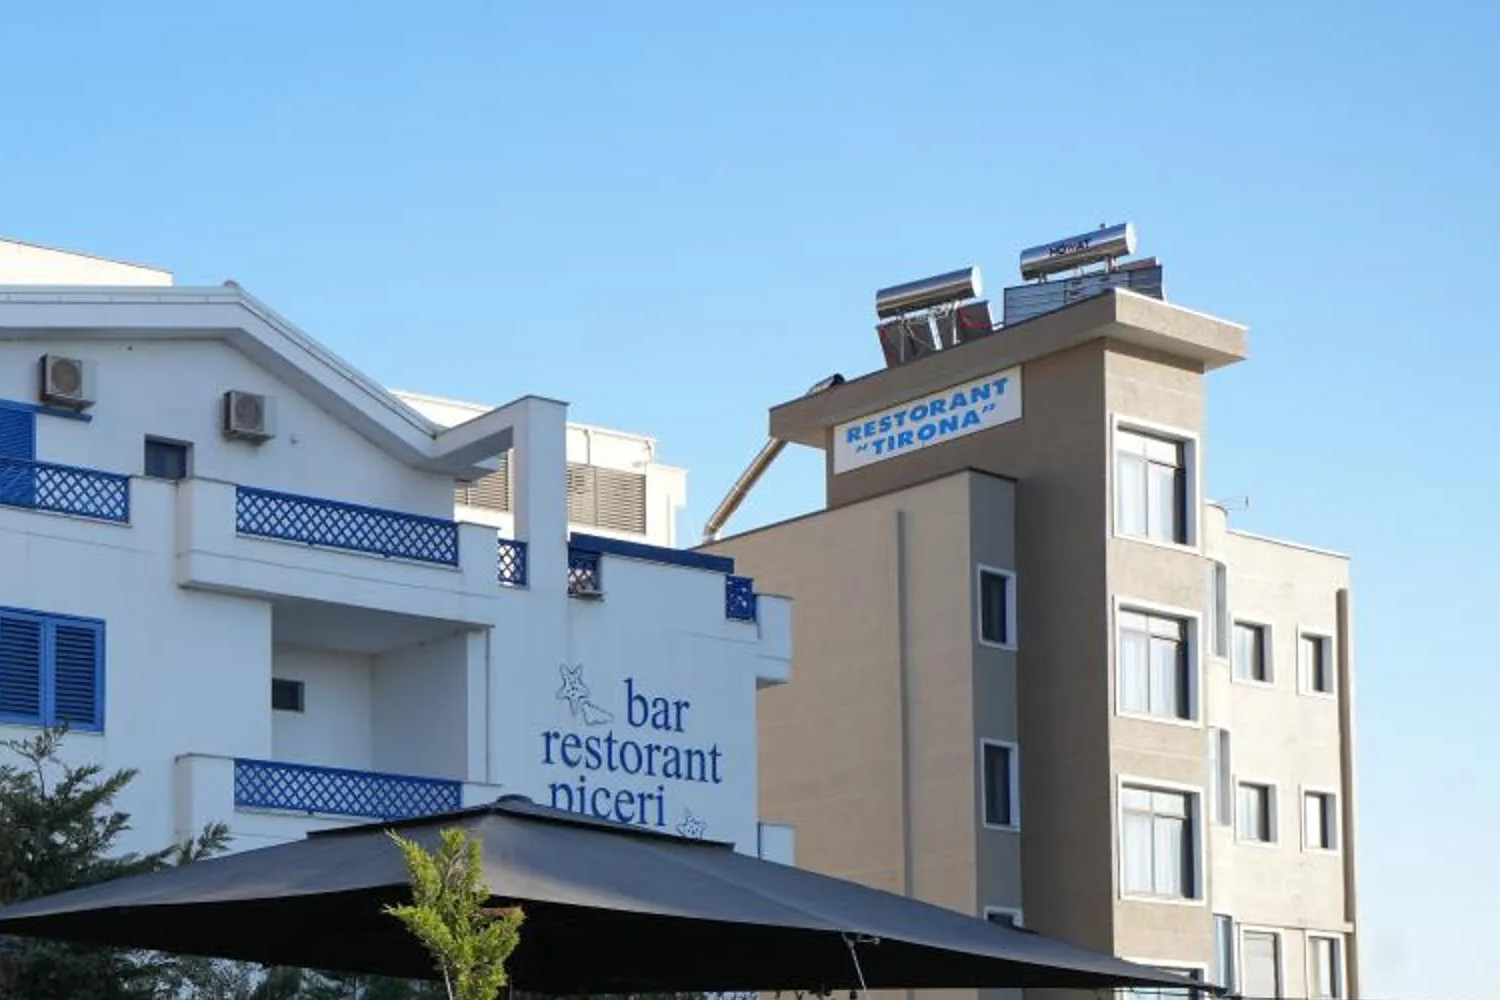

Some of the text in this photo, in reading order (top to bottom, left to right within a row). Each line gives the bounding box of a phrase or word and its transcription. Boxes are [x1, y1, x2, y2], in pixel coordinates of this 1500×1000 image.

[845, 377, 1009, 443] RESTORANT
[623, 677, 691, 733] bar
[540, 729, 723, 784] restorant
